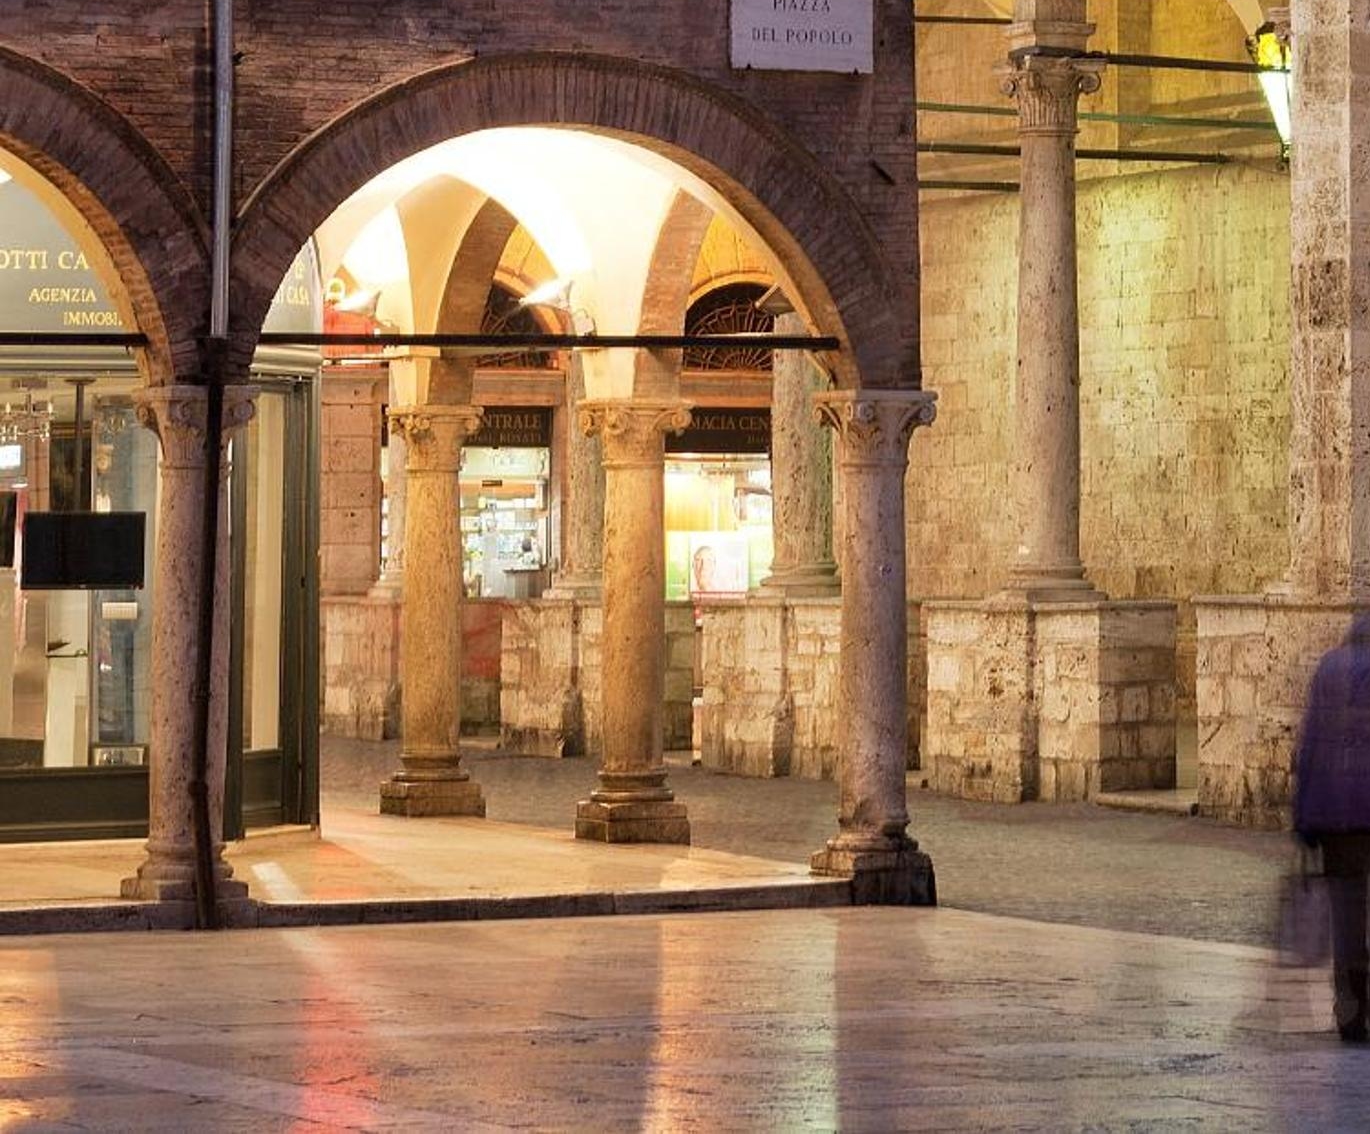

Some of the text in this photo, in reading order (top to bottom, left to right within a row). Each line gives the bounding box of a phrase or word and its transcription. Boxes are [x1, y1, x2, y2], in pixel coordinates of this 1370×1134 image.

[752, 27, 852, 44] DEL POPOLO
[28, 287, 97, 303] AGENZIA
[63, 311, 123, 326] IMMOBI
